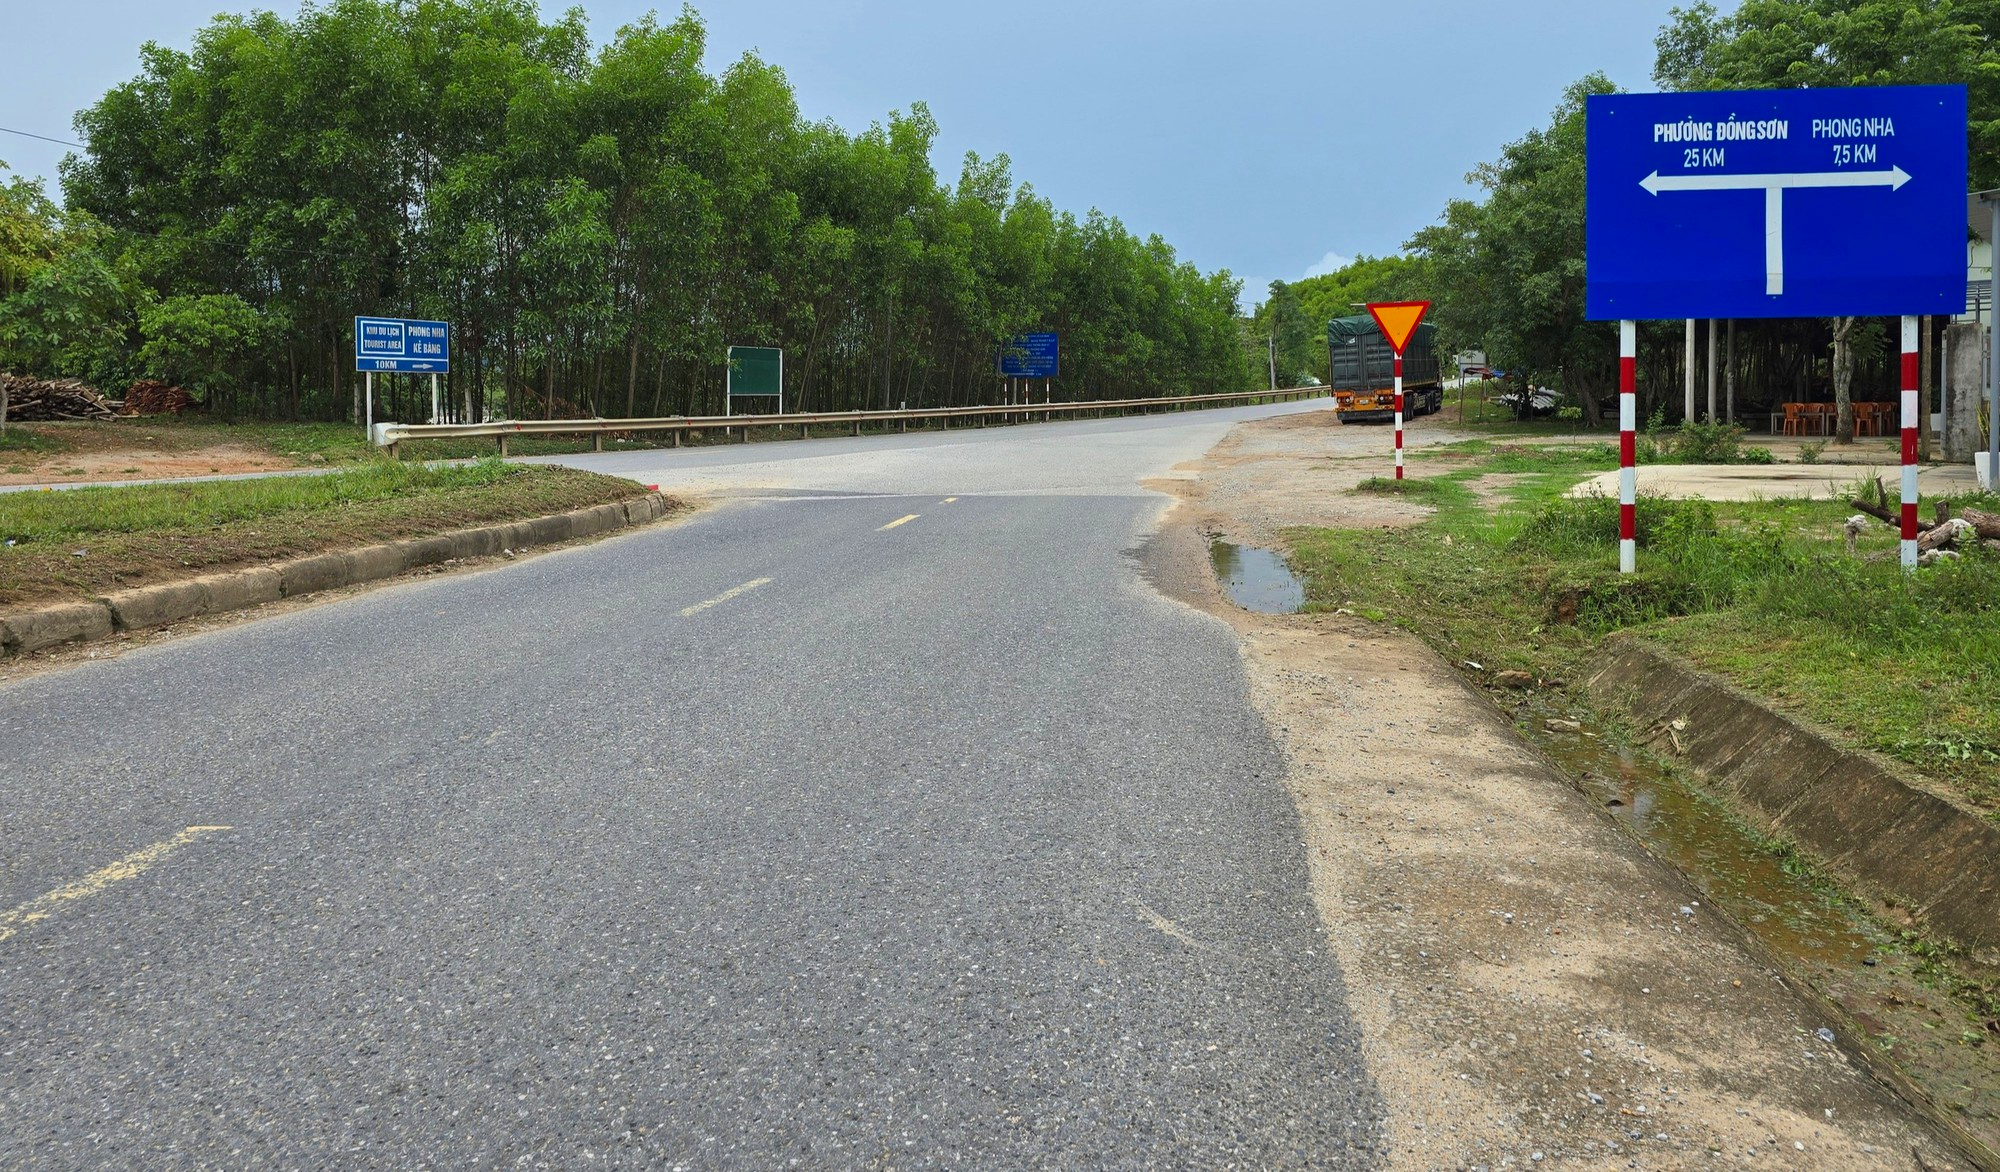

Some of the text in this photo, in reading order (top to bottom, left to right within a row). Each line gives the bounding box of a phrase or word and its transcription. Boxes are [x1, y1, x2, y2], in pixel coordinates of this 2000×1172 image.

[1654, 115, 1713, 142] PHƯỜNG
[1812, 117, 1895, 138] PHONG NHA
[1683, 147, 1724, 167] 25 KM
[1833, 144, 1876, 166] 7,5 KM
[366, 326, 399, 337] KHU DU LỊCH
[408, 326, 445, 338] PHONG NHA
[364, 339, 401, 349] TOURIST AREA
[375, 360, 397, 369] 10KM
